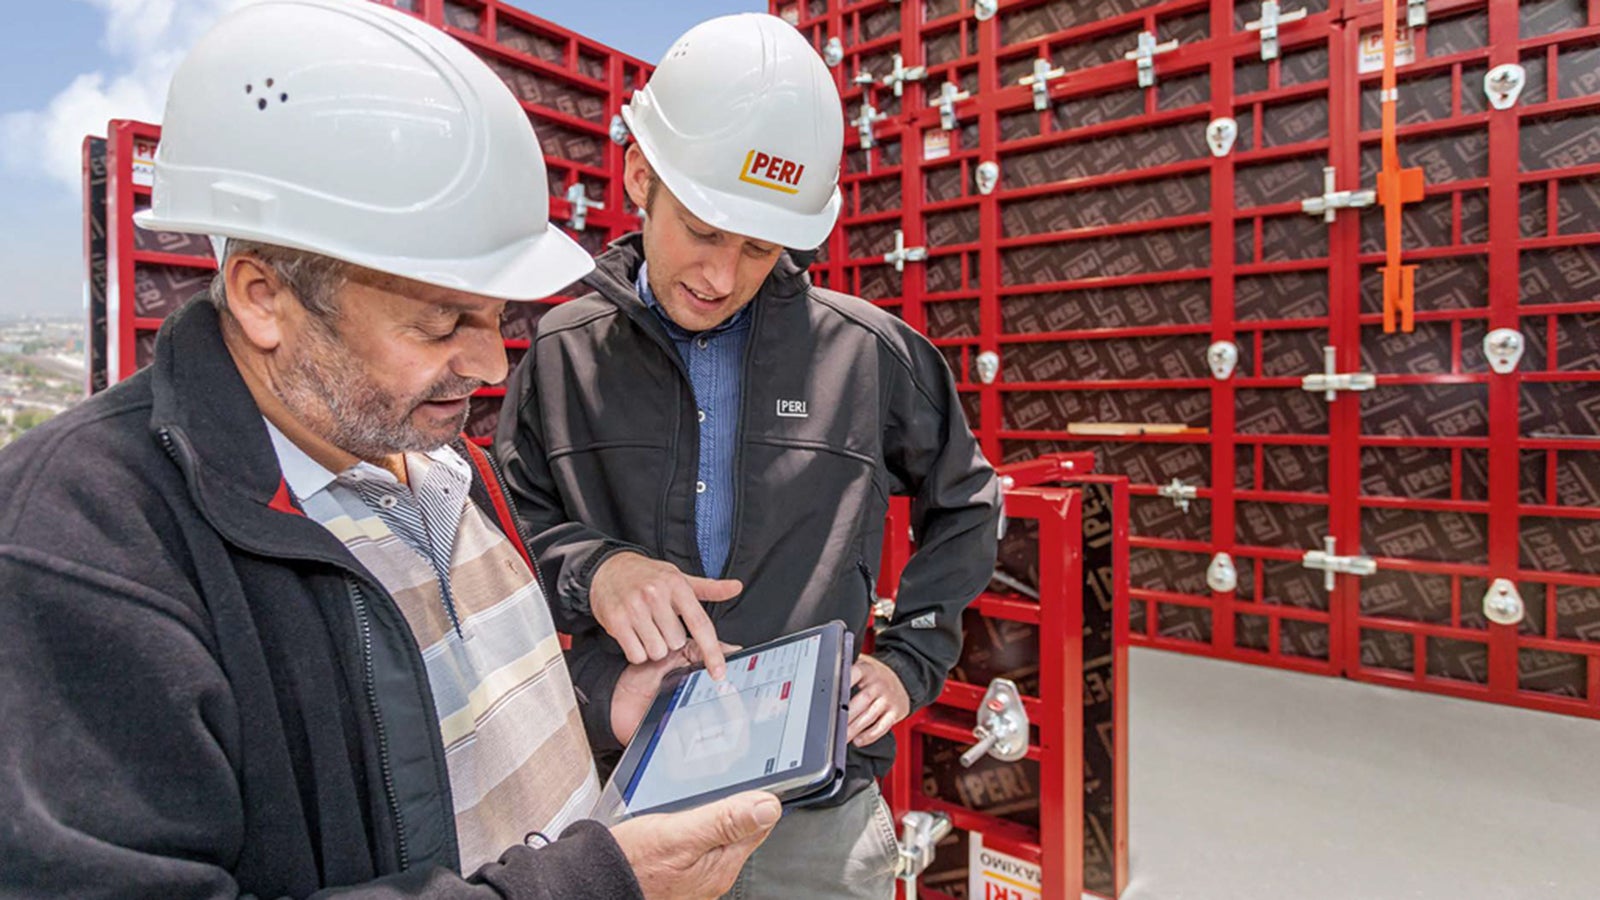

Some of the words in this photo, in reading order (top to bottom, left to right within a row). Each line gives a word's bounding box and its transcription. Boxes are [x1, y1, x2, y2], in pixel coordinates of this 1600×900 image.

[751, 152, 805, 186] PERI
[781, 400, 806, 413] PERI
[964, 765, 1032, 806] PERI
